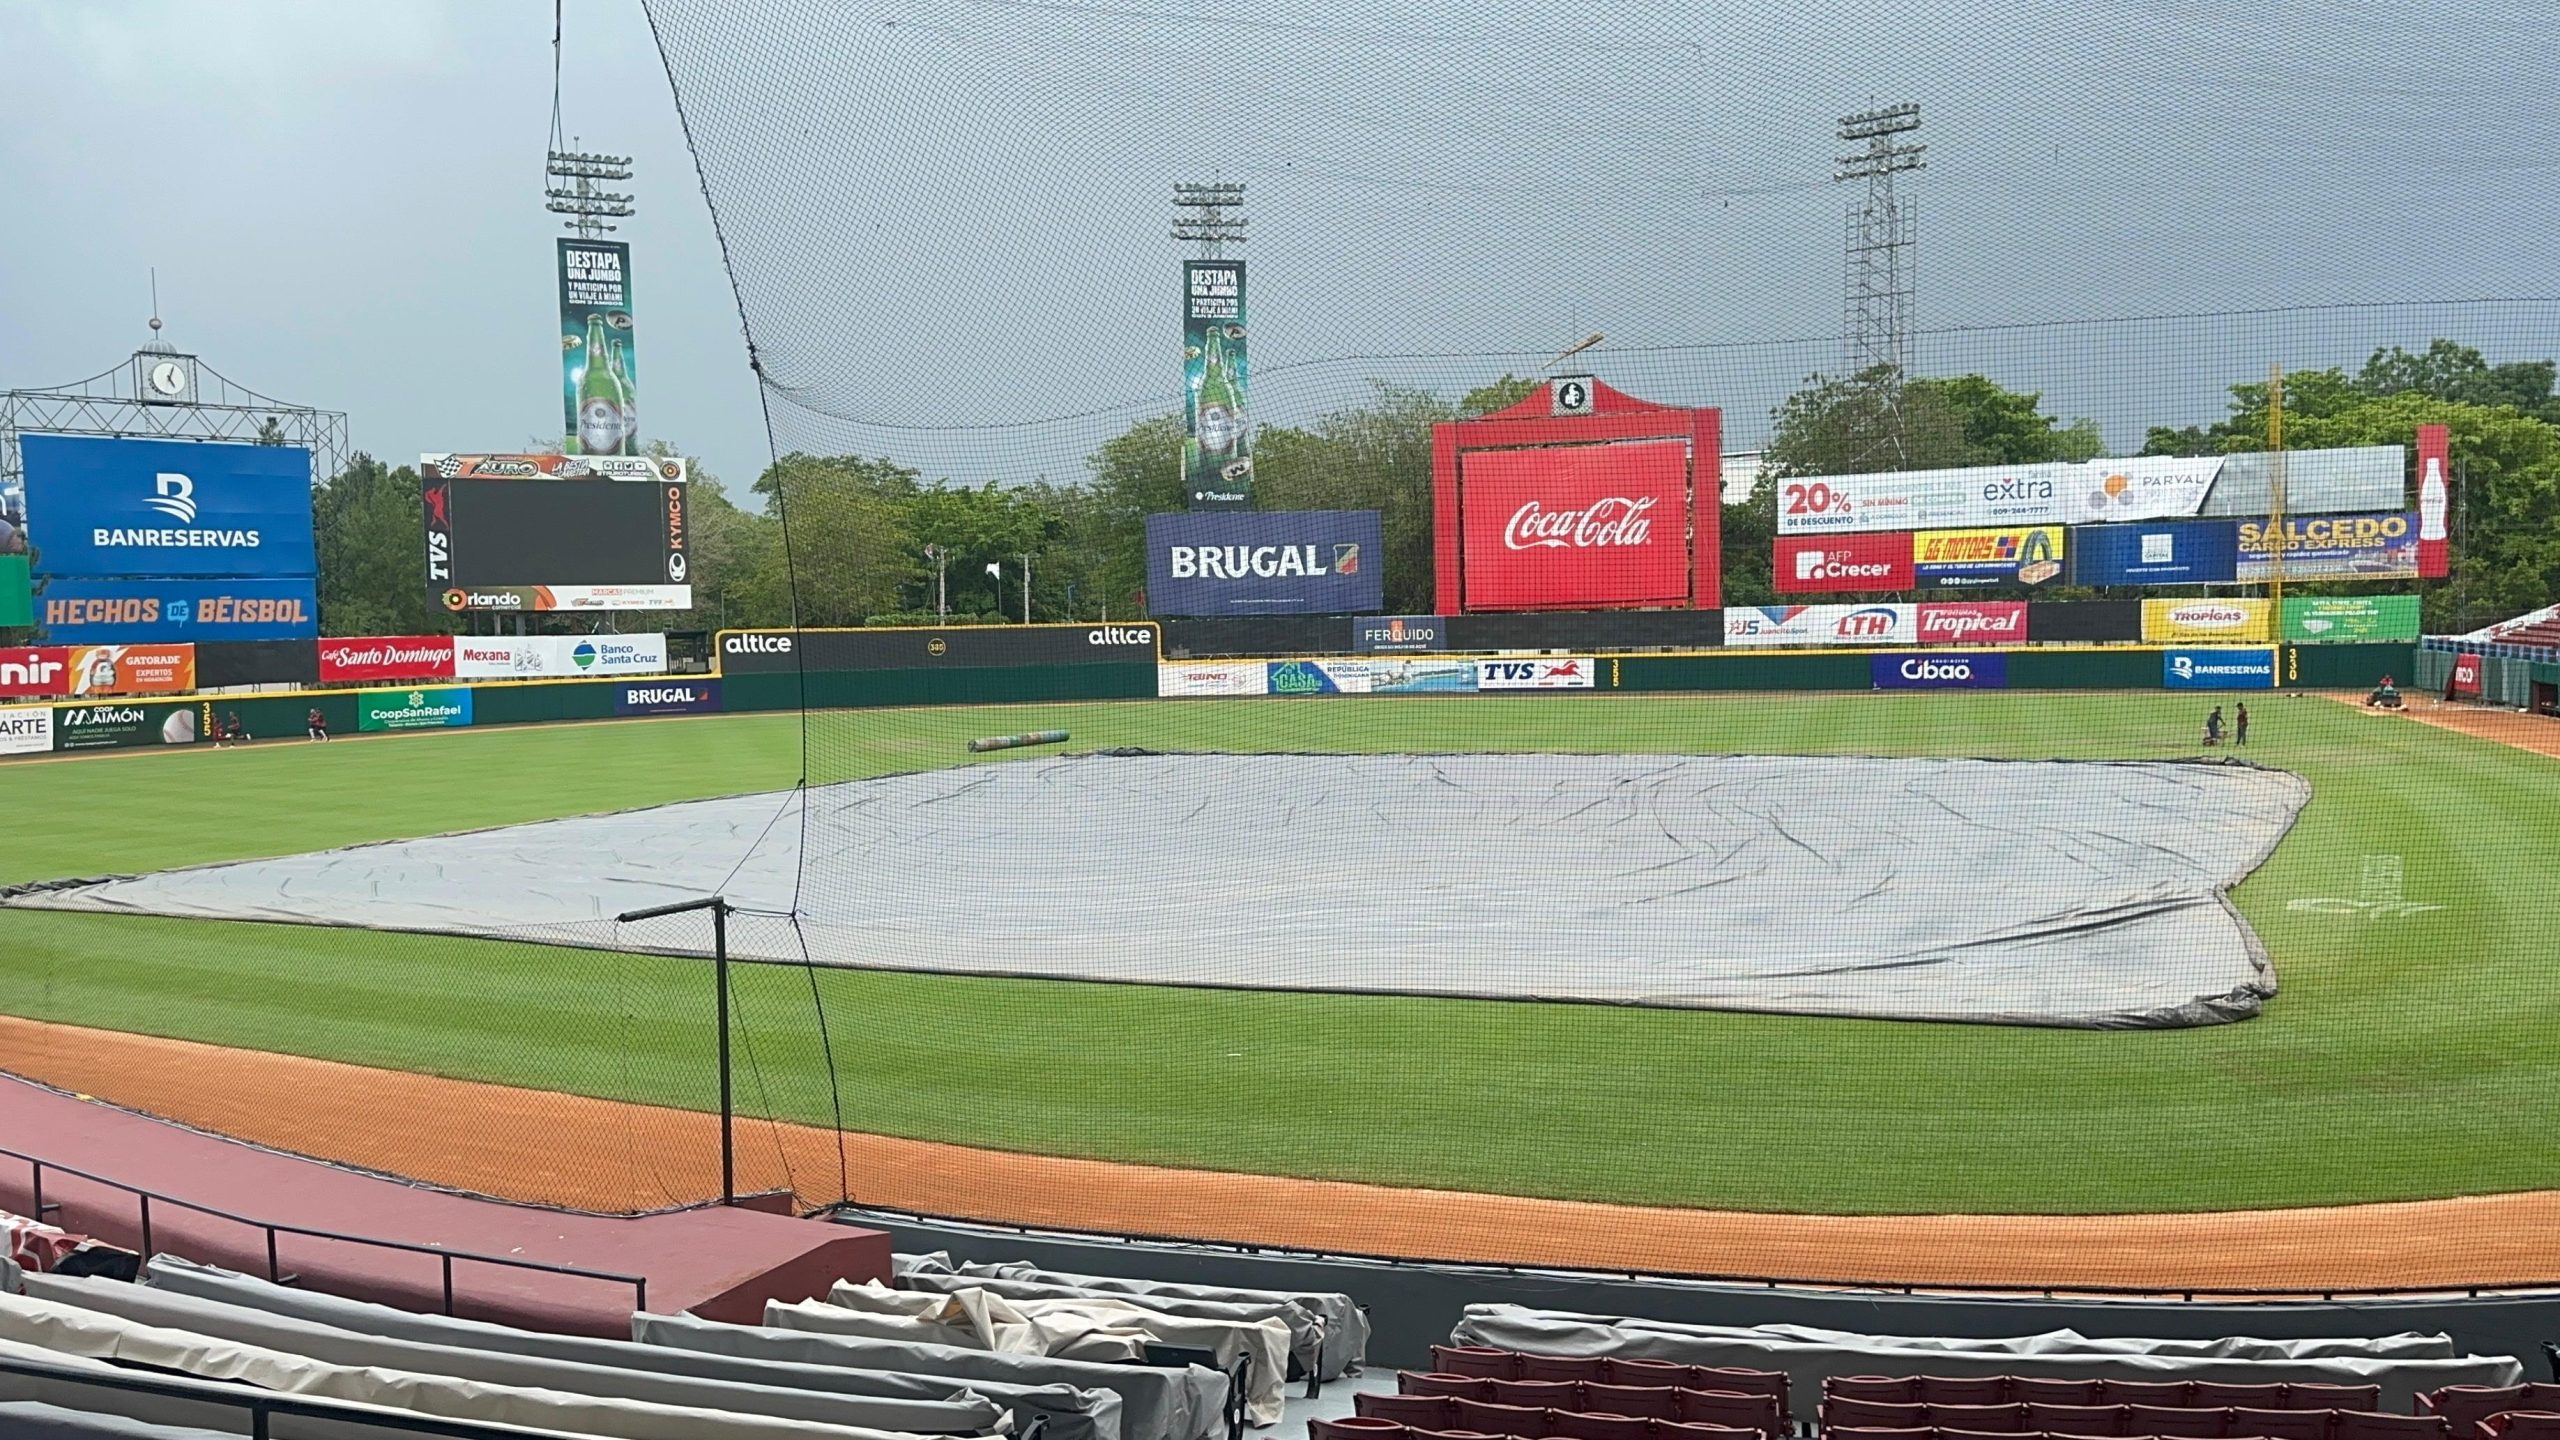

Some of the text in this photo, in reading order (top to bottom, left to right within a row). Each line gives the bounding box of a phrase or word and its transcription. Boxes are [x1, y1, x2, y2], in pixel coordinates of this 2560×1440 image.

[566, 250, 621, 270] DESTAPA
[567, 268, 622, 282] UNA JUMBO
[1191, 270, 1238, 286] DESTAPA
[567, 281, 622, 293] Y PARTICIPA POR
[1191, 285, 1238, 297] UNA JUMBO
[578, 291, 598, 300] VIAJE
[598, 292, 603, 300] A
[603, 292, 623, 302] MIAMI
[1983, 478, 2053, 501] extra
[2142, 474, 2205, 487] PARVAL
[1204, 491, 1245, 501] Presidente
[1785, 482, 1852, 515] 20%
[667, 487, 683, 550] KYMCO
[1504, 496, 1659, 550] Coca-Cola
[1787, 516, 1854, 527] DE DESCUENTO
[93, 528, 260, 547] BANRESERVAS
[2238, 516, 2407, 543] SALCEDO
[2238, 537, 2386, 552] CARGO EXPRESS
[428, 531, 449, 581] TVS
[1170, 543, 1328, 580] BRUGAL
[1827, 550, 1852, 561] AFP
[1826, 561, 1892, 577] Crecer
[441, 588, 521, 611] Orlando
[46, 598, 160, 625] HECHOS
[197, 595, 309, 624] BÉISBOL
[1837, 616, 1888, 636] LTH
[1922, 609, 2021, 639] Tropical
[725, 633, 792, 653] altice
[1088, 625, 1152, 645] altice
[1365, 628, 1434, 642] FERQUIDO
[321, 645, 453, 670] Café Santo Domingo
[463, 648, 511, 662] Mexana
[601, 644, 634, 655] Banco
[125, 655, 181, 666] GATORADE
[601, 653, 658, 665] Santa Cruz
[2289, 648, 2297, 680] 330
[135, 668, 173, 677] EXPERTOS
[1484, 662, 1535, 681] TVS
[1900, 658, 1970, 680] Cibao
[2194, 665, 2271, 675] BANRESERVAS
[627, 687, 695, 705] BRUGAL
[203, 702, 211, 737] 355
[370, 704, 462, 720] CoopSanRafael
[0, 718, 47, 735] ARTE
